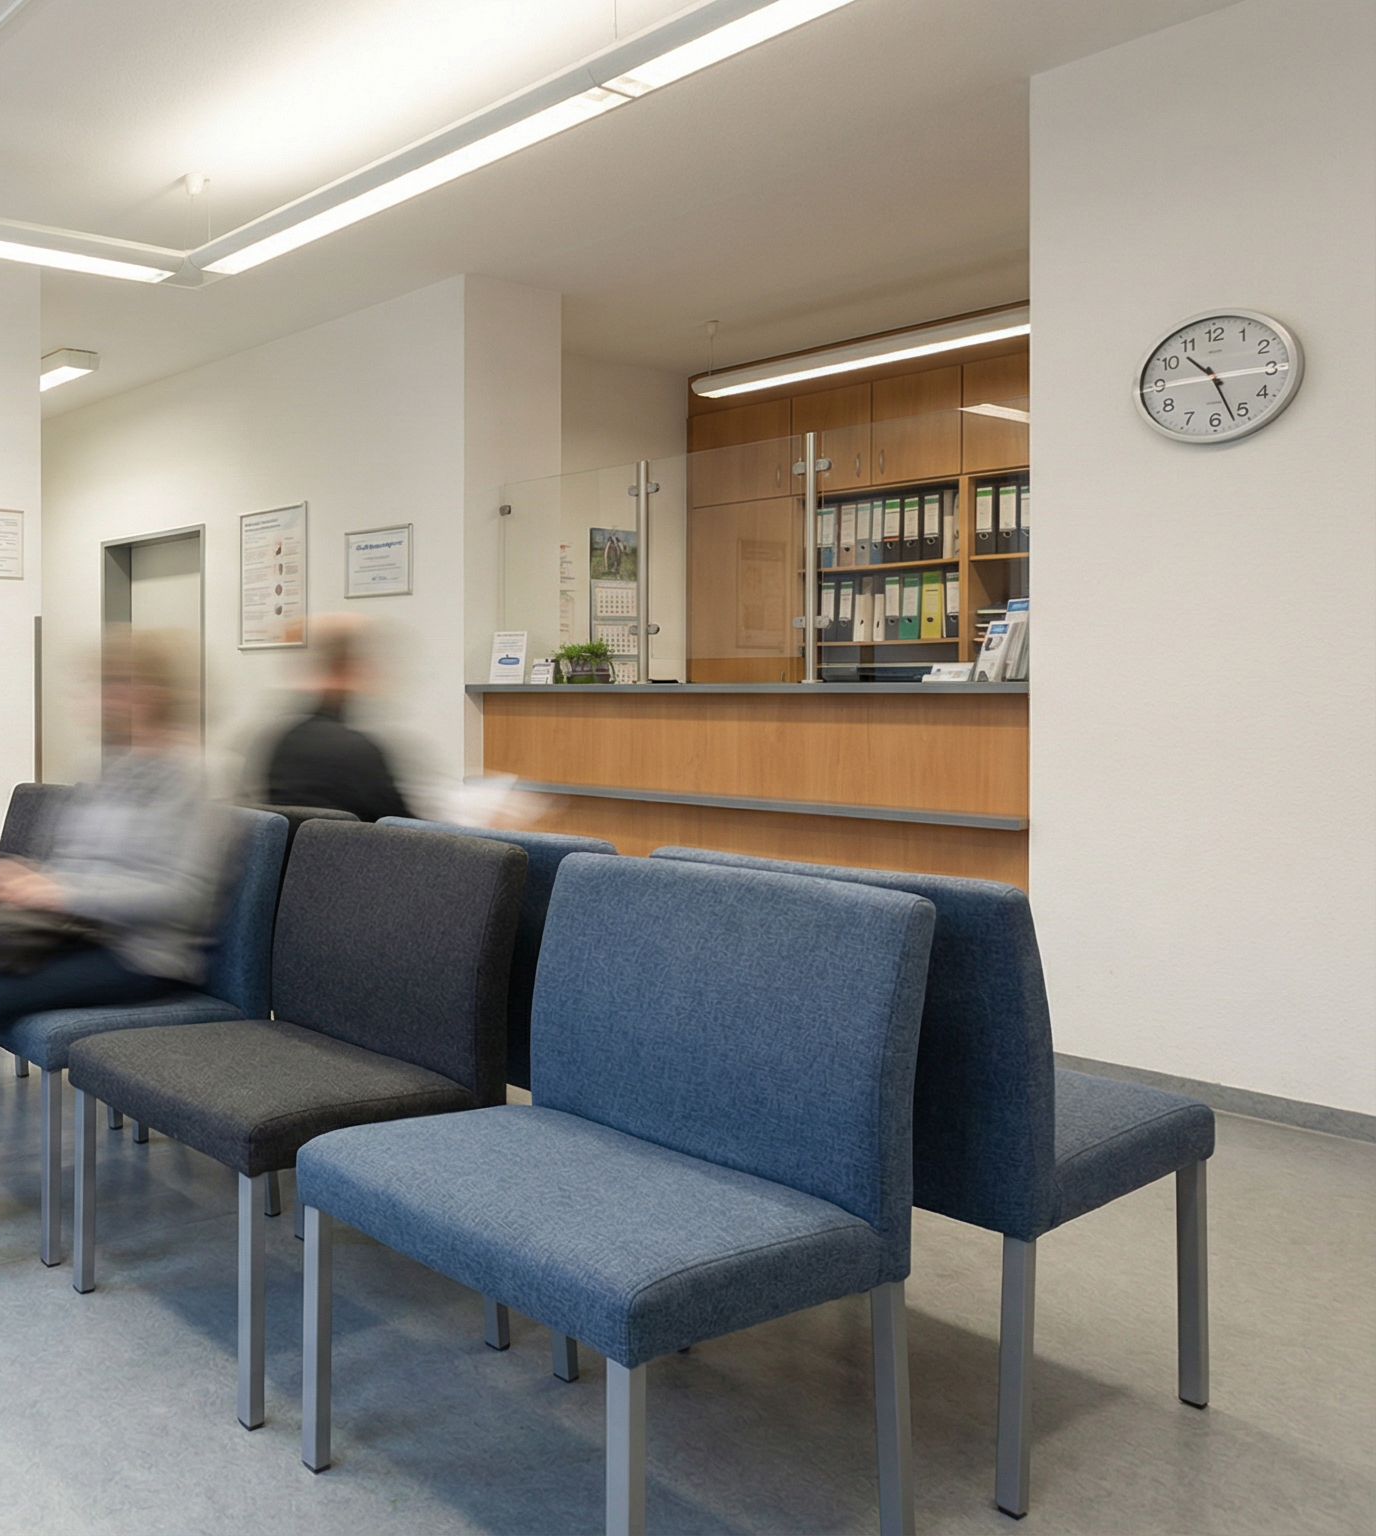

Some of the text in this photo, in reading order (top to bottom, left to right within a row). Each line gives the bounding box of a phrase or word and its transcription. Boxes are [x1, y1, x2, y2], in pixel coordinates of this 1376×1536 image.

[1205, 327, 1225, 342] 12
[1238, 327, 1246, 342] 1
[1180, 338, 1195, 353] 11
[1257, 339, 1270, 354] 2
[1162, 355, 1180, 371] 10
[1265, 360, 1278, 376] 3
[1154, 378, 1165, 393] 9
[1256, 384, 1269, 399] 4
[1162, 398, 1175, 413] 8
[1236, 402, 1249, 417] 5
[1184, 411, 1195, 426] 7
[1209, 413, 1222, 428] 6
